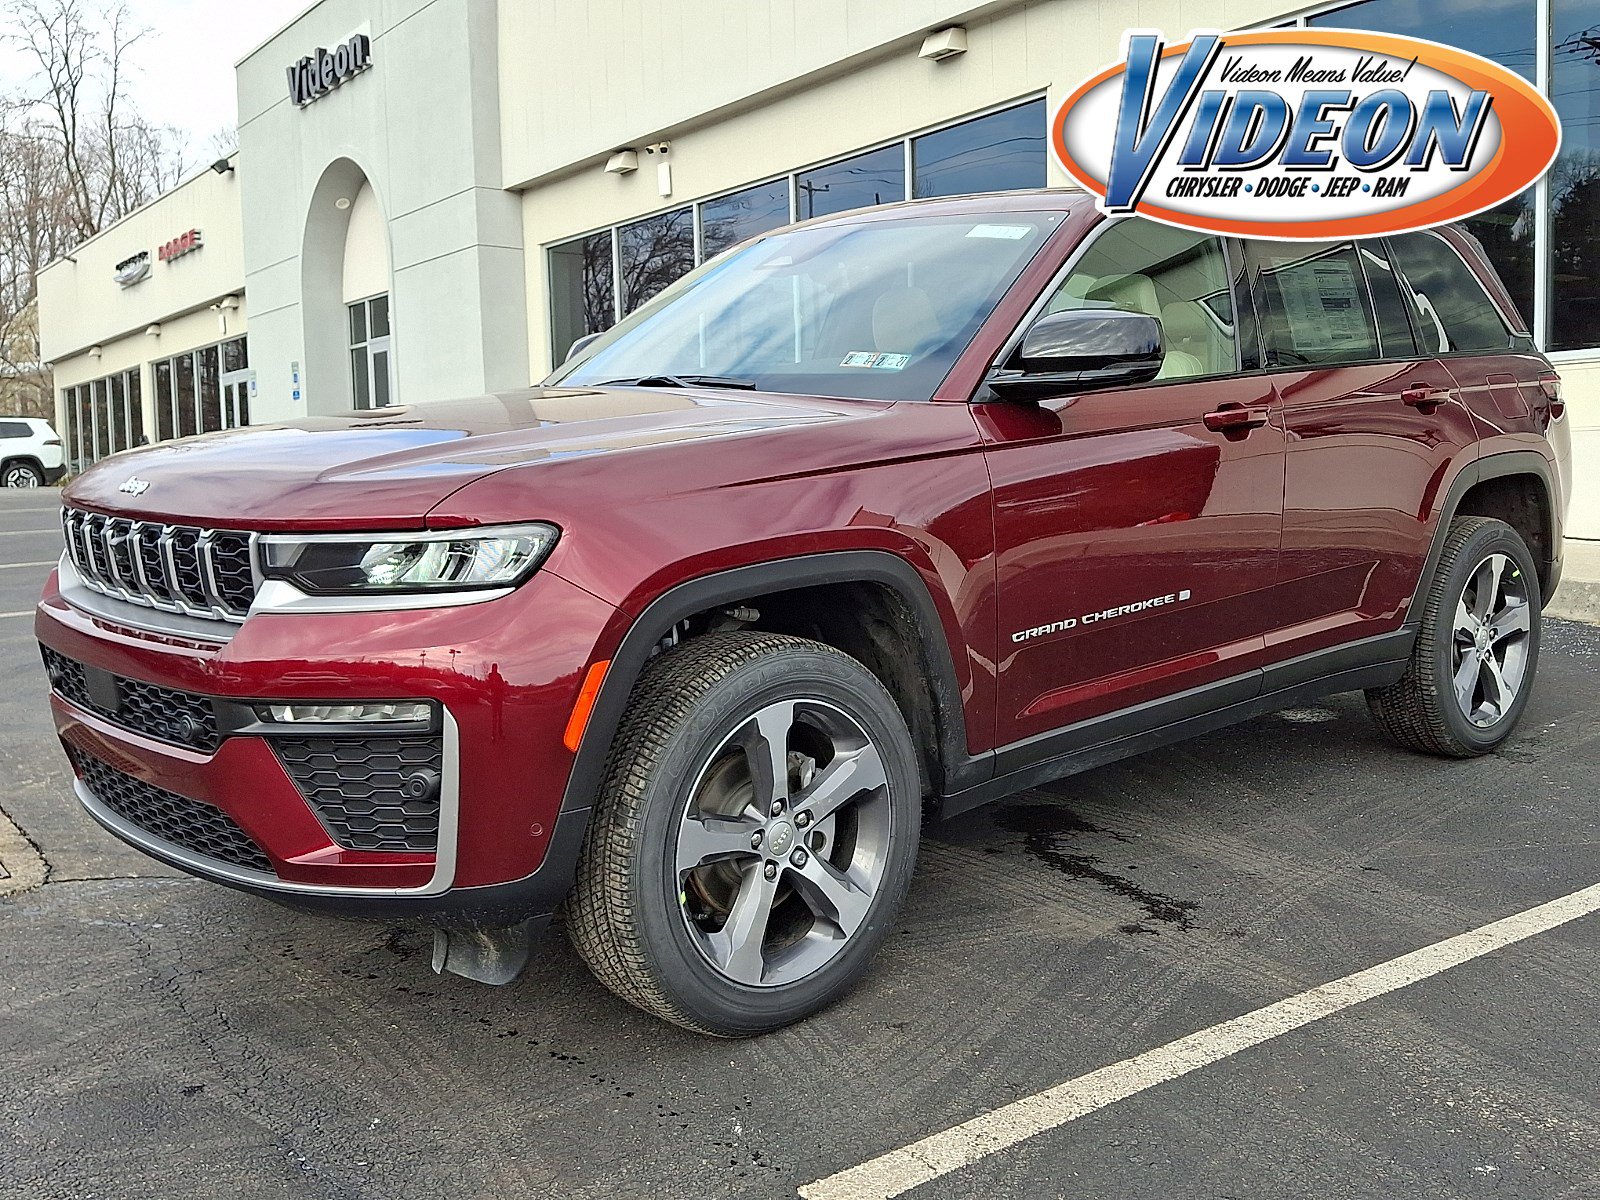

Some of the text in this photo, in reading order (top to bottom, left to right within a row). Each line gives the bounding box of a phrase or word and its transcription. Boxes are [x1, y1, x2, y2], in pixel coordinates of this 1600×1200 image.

[286, 33, 370, 106] Videon
[1011, 593, 1175, 643] GRAND CHEROKEE
